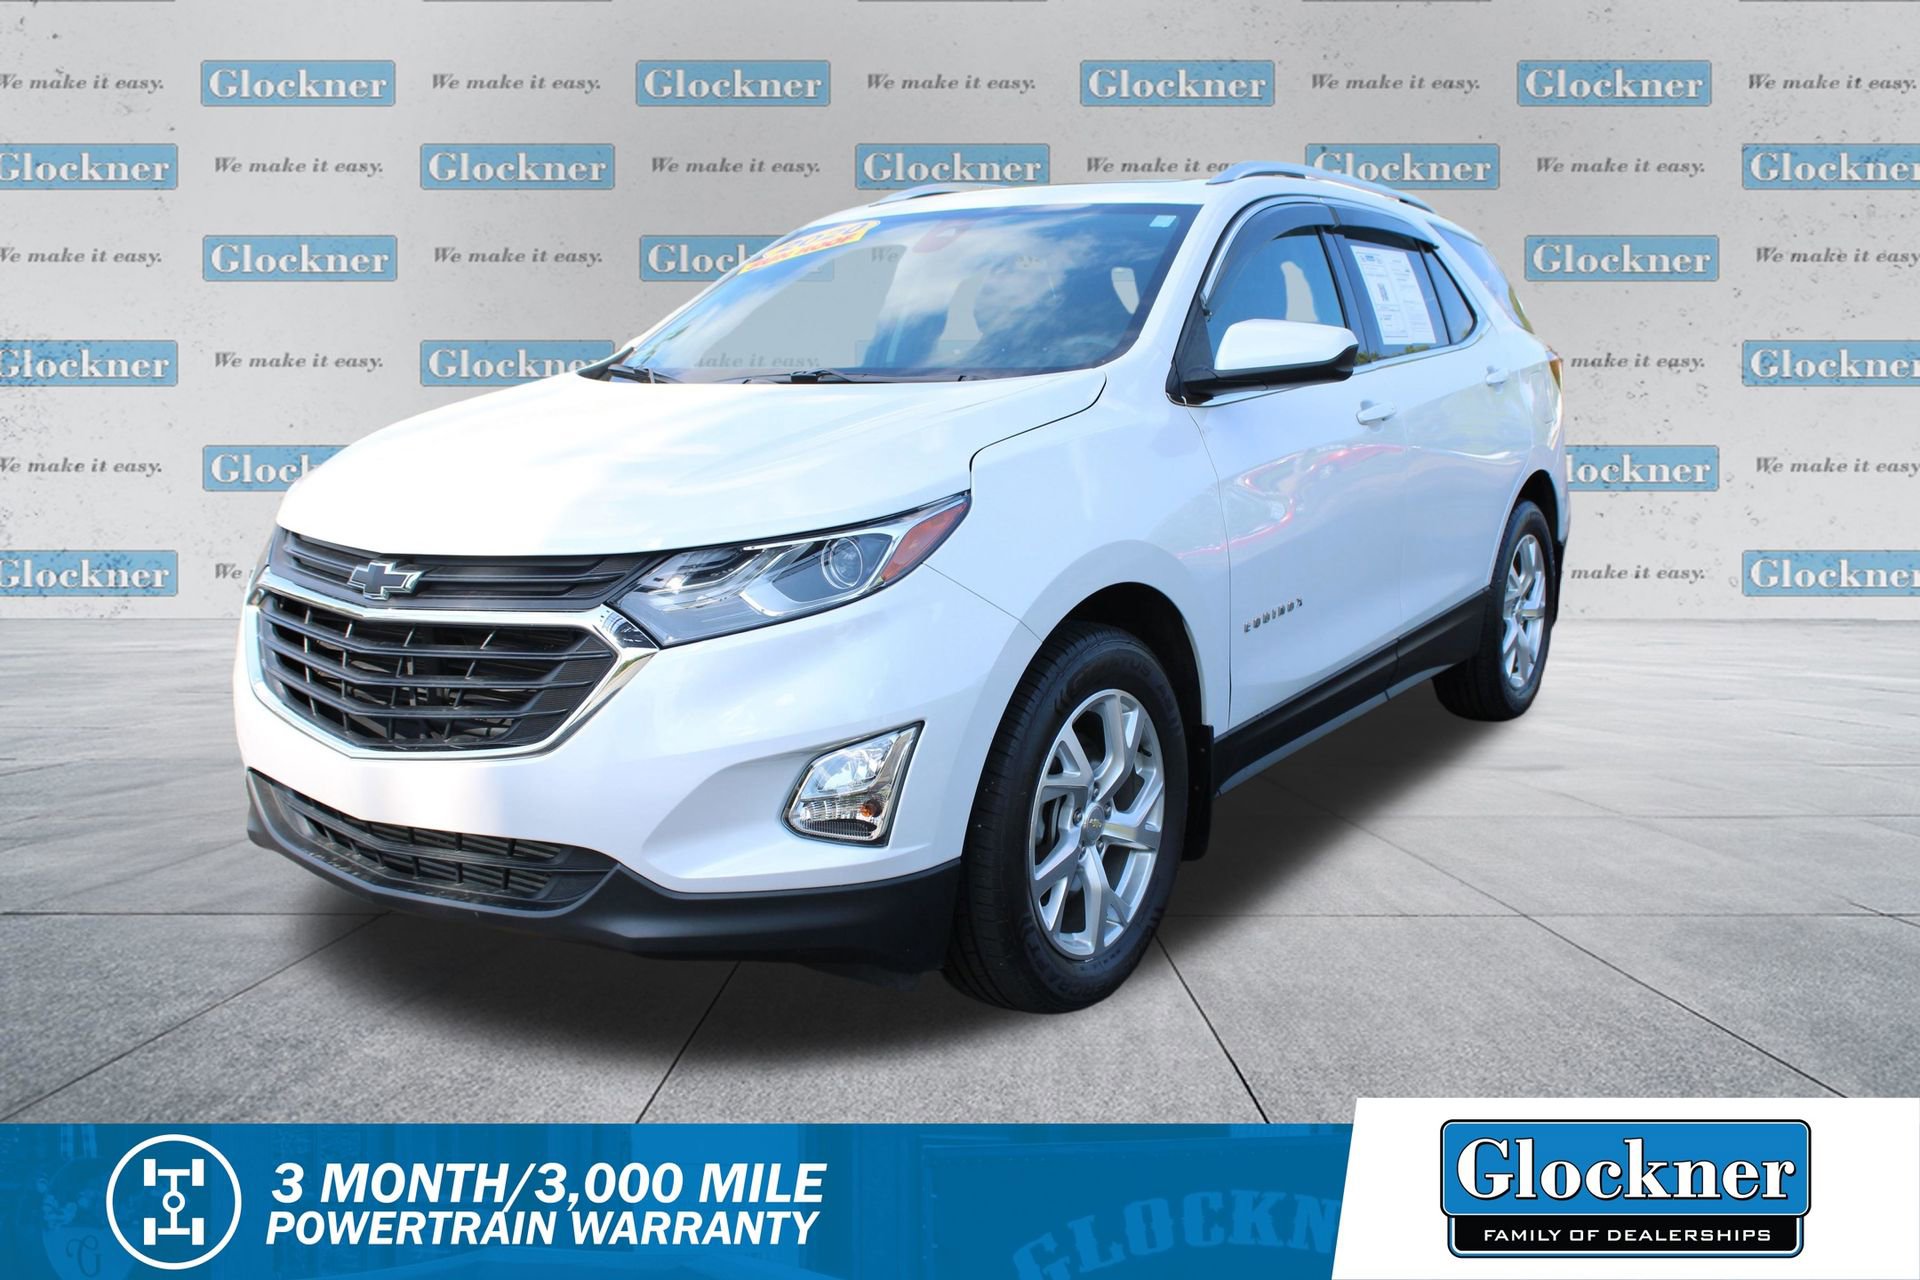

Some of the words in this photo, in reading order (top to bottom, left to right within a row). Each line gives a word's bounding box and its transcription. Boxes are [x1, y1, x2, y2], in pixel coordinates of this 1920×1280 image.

[29, 73, 87, 90] make
[92, 74, 109, 90] it
[115, 79, 165, 95] easy.
[209, 69, 388, 97] Glockner
[432, 73, 460, 90] We
[466, 73, 524, 90] make
[529, 74, 546, 90] it
[552, 79, 602, 95] easy.
[644, 69, 823, 97] Glockner
[867, 73, 895, 90] We
[901, 73, 959, 90] make
[964, 74, 981, 90] it
[987, 79, 1037, 95] easy.
[1088, 69, 1267, 97] Glockner
[1311, 73, 1339, 90] We
[1345, 73, 1403, 90] make
[1408, 74, 1425, 90] it
[1431, 79, 1481, 95] easy.
[1525, 69, 1704, 97] Glockner
[1748, 73, 1776, 90] We
[1782, 73, 1840, 90] make
[1845, 74, 1862, 90] it
[1868, 79, 1918, 95] easy.
[215, 156, 243, 173] We
[249, 156, 307, 173] make
[312, 157, 329, 173] it
[335, 162, 385, 178] easy.
[428, 152, 607, 180] Glockner
[651, 156, 679, 173] We
[685, 156, 743, 173] make
[748, 157, 765, 173] it
[771, 162, 821, 178] easy.
[863, 152, 1042, 180] Glockner
[1086, 156, 1114, 173] We
[1120, 156, 1178, 173] make
[1183, 157, 1200, 173] it
[1536, 156, 1564, 173] We
[1570, 156, 1628, 173] make
[1633, 157, 1650, 173] it
[1656, 162, 1706, 178] easy.
[27, 246, 85, 263] make
[90, 247, 107, 263] it
[113, 252, 163, 268] easy.
[211, 244, 390, 272] Glockner
[434, 246, 462, 263] We
[468, 246, 526, 263] make
[531, 247, 548, 263] it
[554, 252, 604, 268] easy.
[648, 244, 752, 273] Gloc
[1533, 244, 1712, 272] Glockner
[1756, 246, 1784, 263] We
[1790, 246, 1848, 263] make
[1853, 247, 1870, 263] it
[215, 351, 243, 368] We
[249, 351, 307, 368] make
[312, 352, 329, 368] it
[335, 357, 385, 373] easy.
[1570, 351, 1628, 368] make
[1633, 352, 1650, 368] it
[1656, 357, 1706, 373] easy.
[27, 456, 85, 473] make
[90, 457, 107, 473] it
[113, 462, 163, 478] easy.
[211, 453, 320, 483] Gloc
[1565, 454, 1712, 483] lockner
[1756, 456, 1784, 473] We
[1790, 456, 1848, 473] make
[1853, 457, 1870, 473] it
[215, 562, 243, 579] We
[1570, 562, 1628, 579] make
[1633, 563, 1650, 579] it
[1656, 568, 1706, 584] easy.
